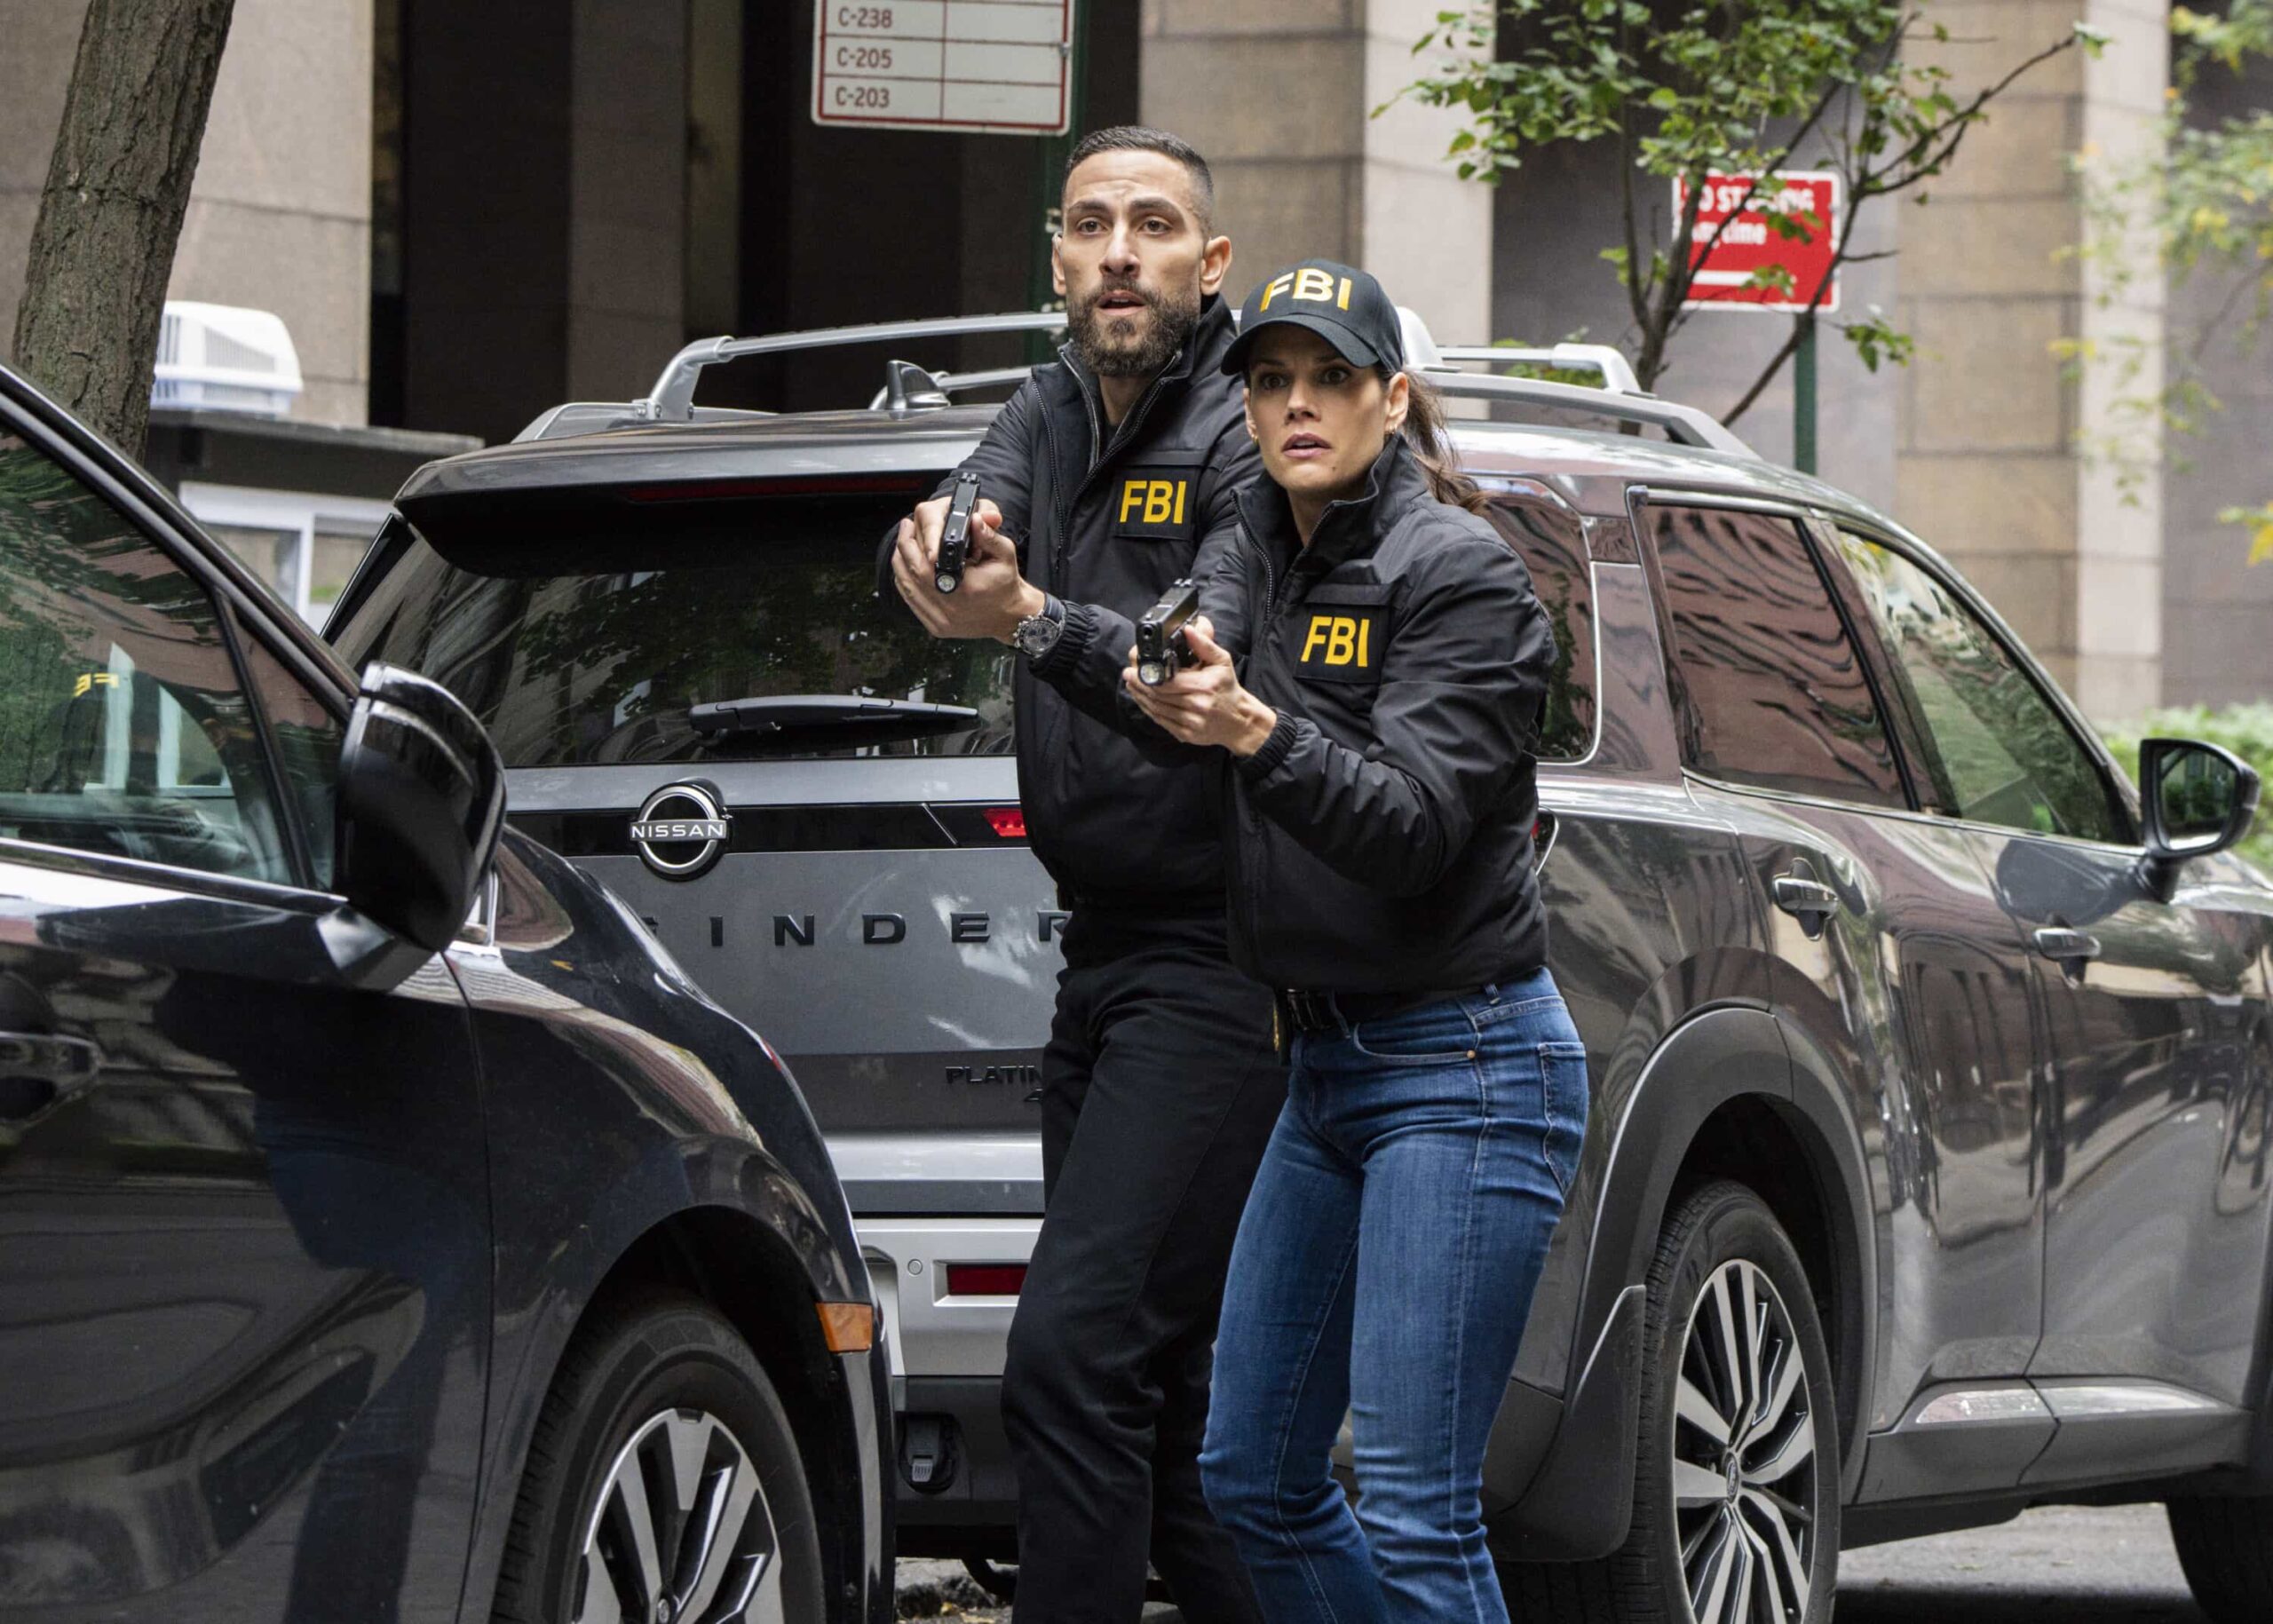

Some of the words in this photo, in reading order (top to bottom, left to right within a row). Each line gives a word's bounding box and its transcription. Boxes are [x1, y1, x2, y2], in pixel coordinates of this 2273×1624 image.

[837, 7, 892, 28] C-238
[836, 46, 892, 68] C-205
[835, 86, 890, 108] C-203
[1260, 268, 1351, 312] FBI
[1119, 480, 1186, 524] FBI
[1301, 615, 1370, 668] FBI
[631, 824, 724, 838] NISSAN
